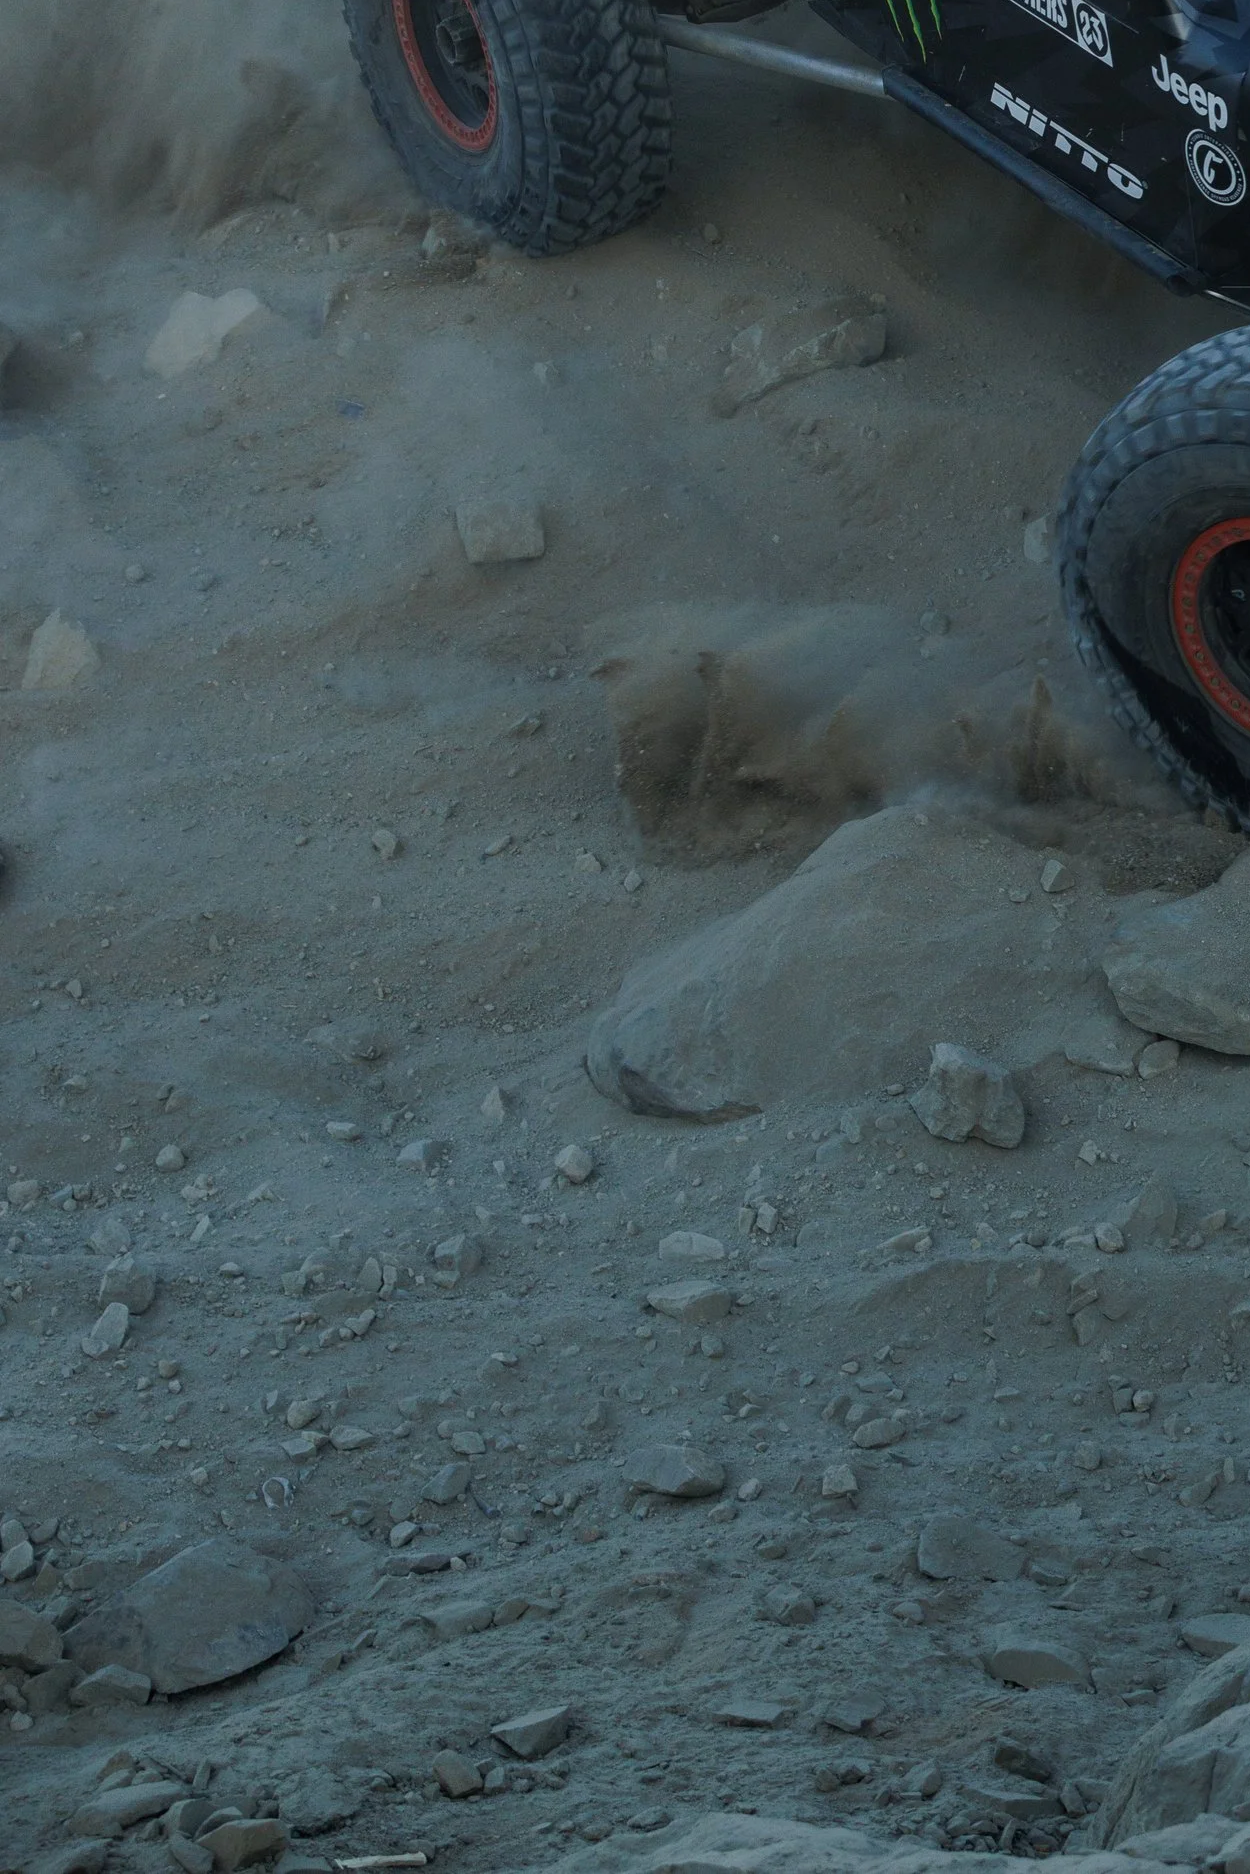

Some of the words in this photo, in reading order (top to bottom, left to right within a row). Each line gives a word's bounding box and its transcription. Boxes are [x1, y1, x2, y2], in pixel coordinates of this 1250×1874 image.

[1079, 9, 1105, 52] 23
[1151, 53, 1229, 132] Jeep
[989, 81, 1146, 200] NITTO
